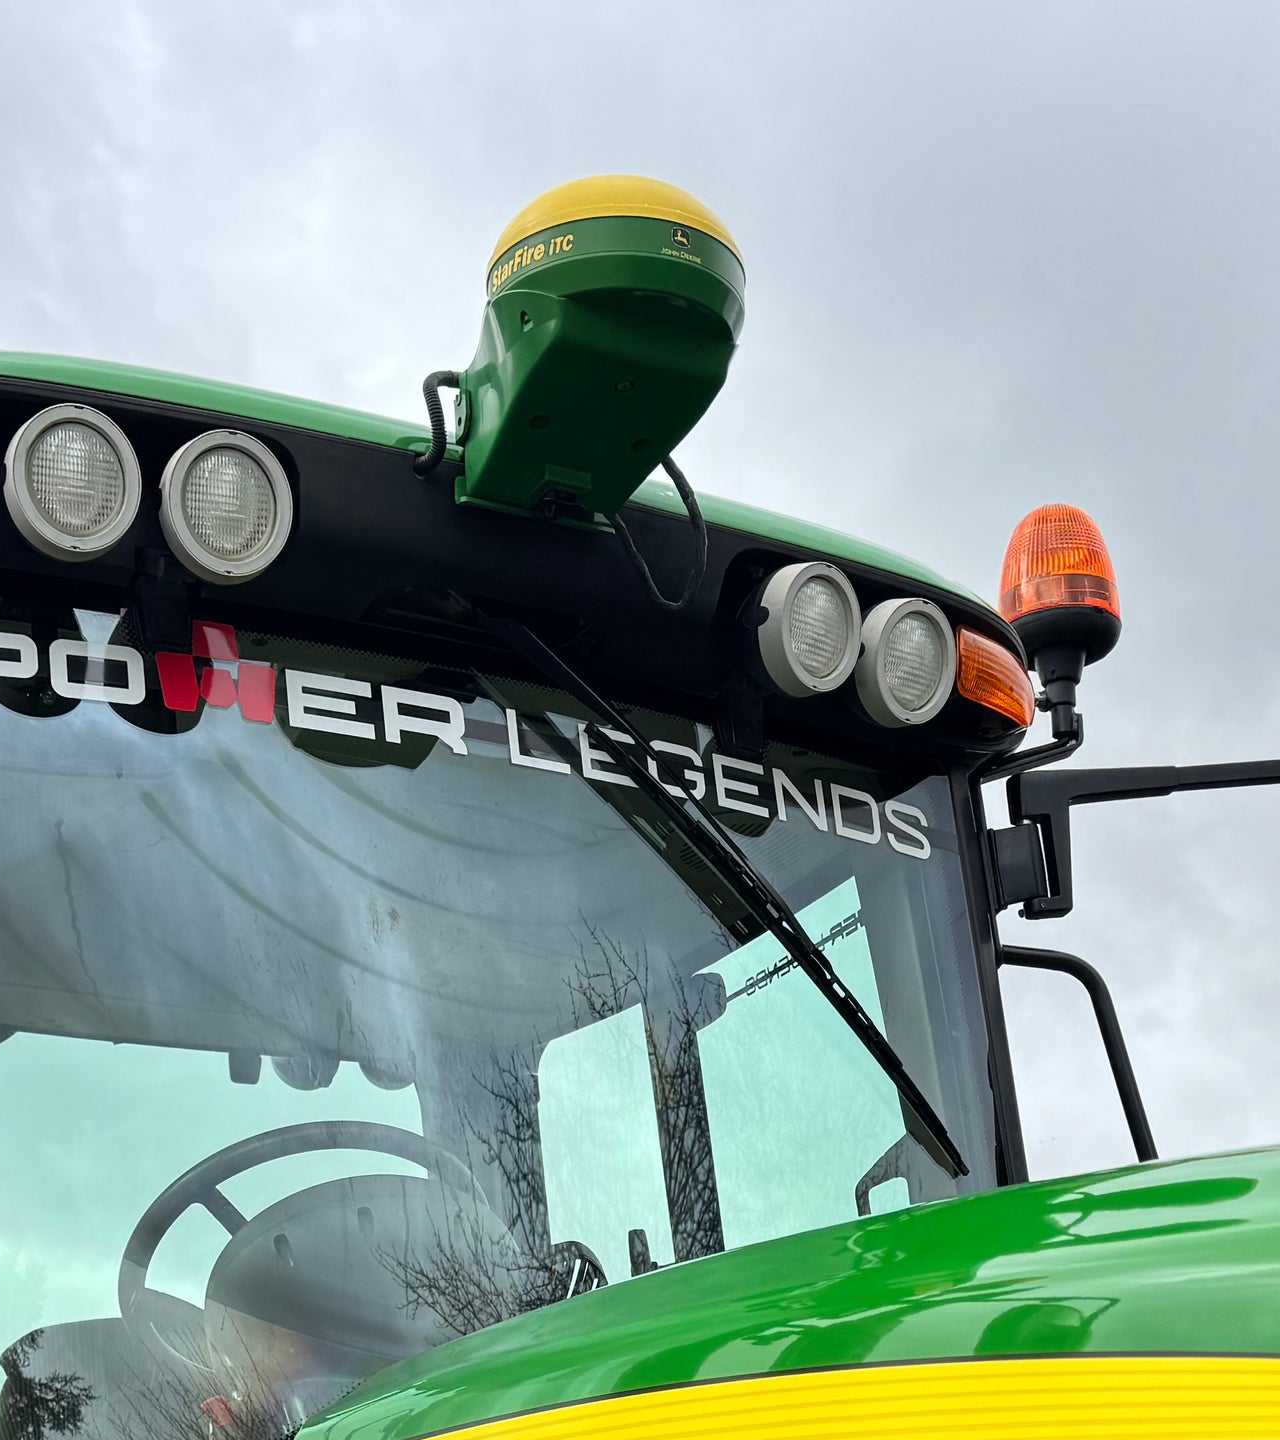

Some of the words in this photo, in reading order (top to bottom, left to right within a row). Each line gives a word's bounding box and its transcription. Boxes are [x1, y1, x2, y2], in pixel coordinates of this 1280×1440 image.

[491, 243, 545, 292] StarFire
[549, 234, 574, 256] iTC
[505, 707, 932, 860] LEGENDS
